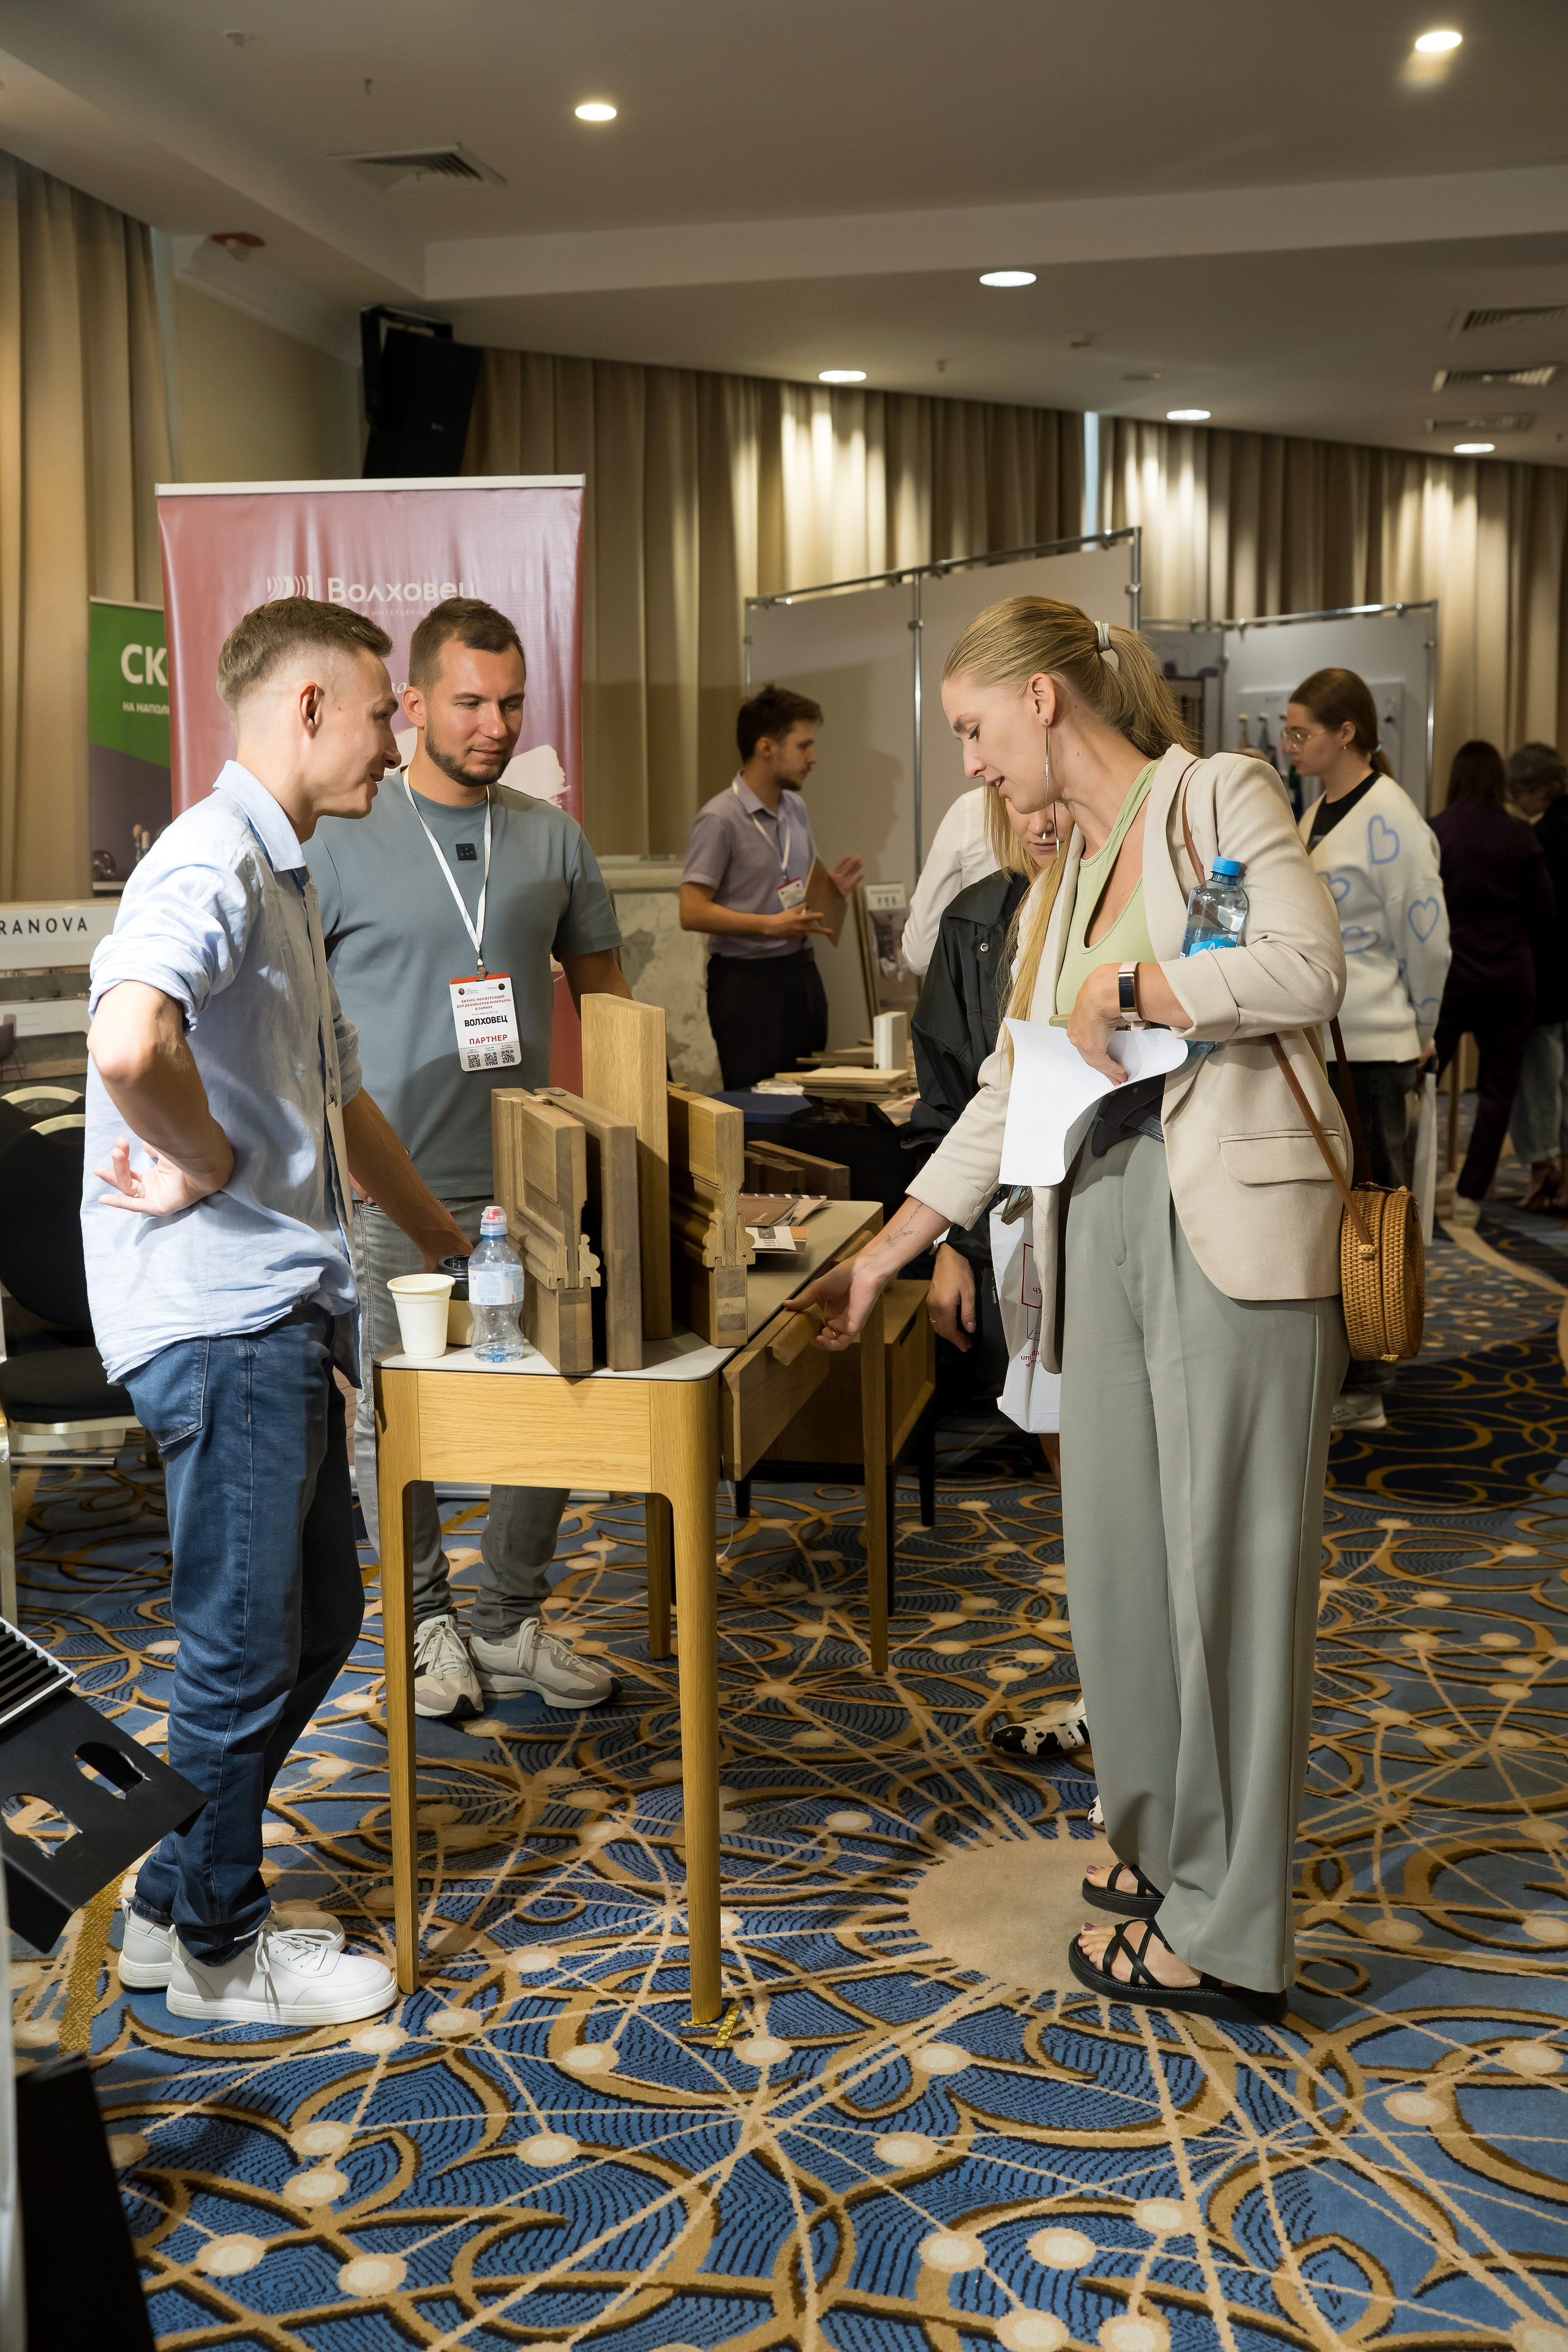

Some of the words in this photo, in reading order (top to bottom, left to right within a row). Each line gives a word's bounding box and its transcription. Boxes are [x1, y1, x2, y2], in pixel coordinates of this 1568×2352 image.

[328, 578, 477, 602] Волховец
[464, 1015, 508, 1027] ВОЛХОВЕЦ
[469, 1034, 508, 1045] ПАРТНЕР
